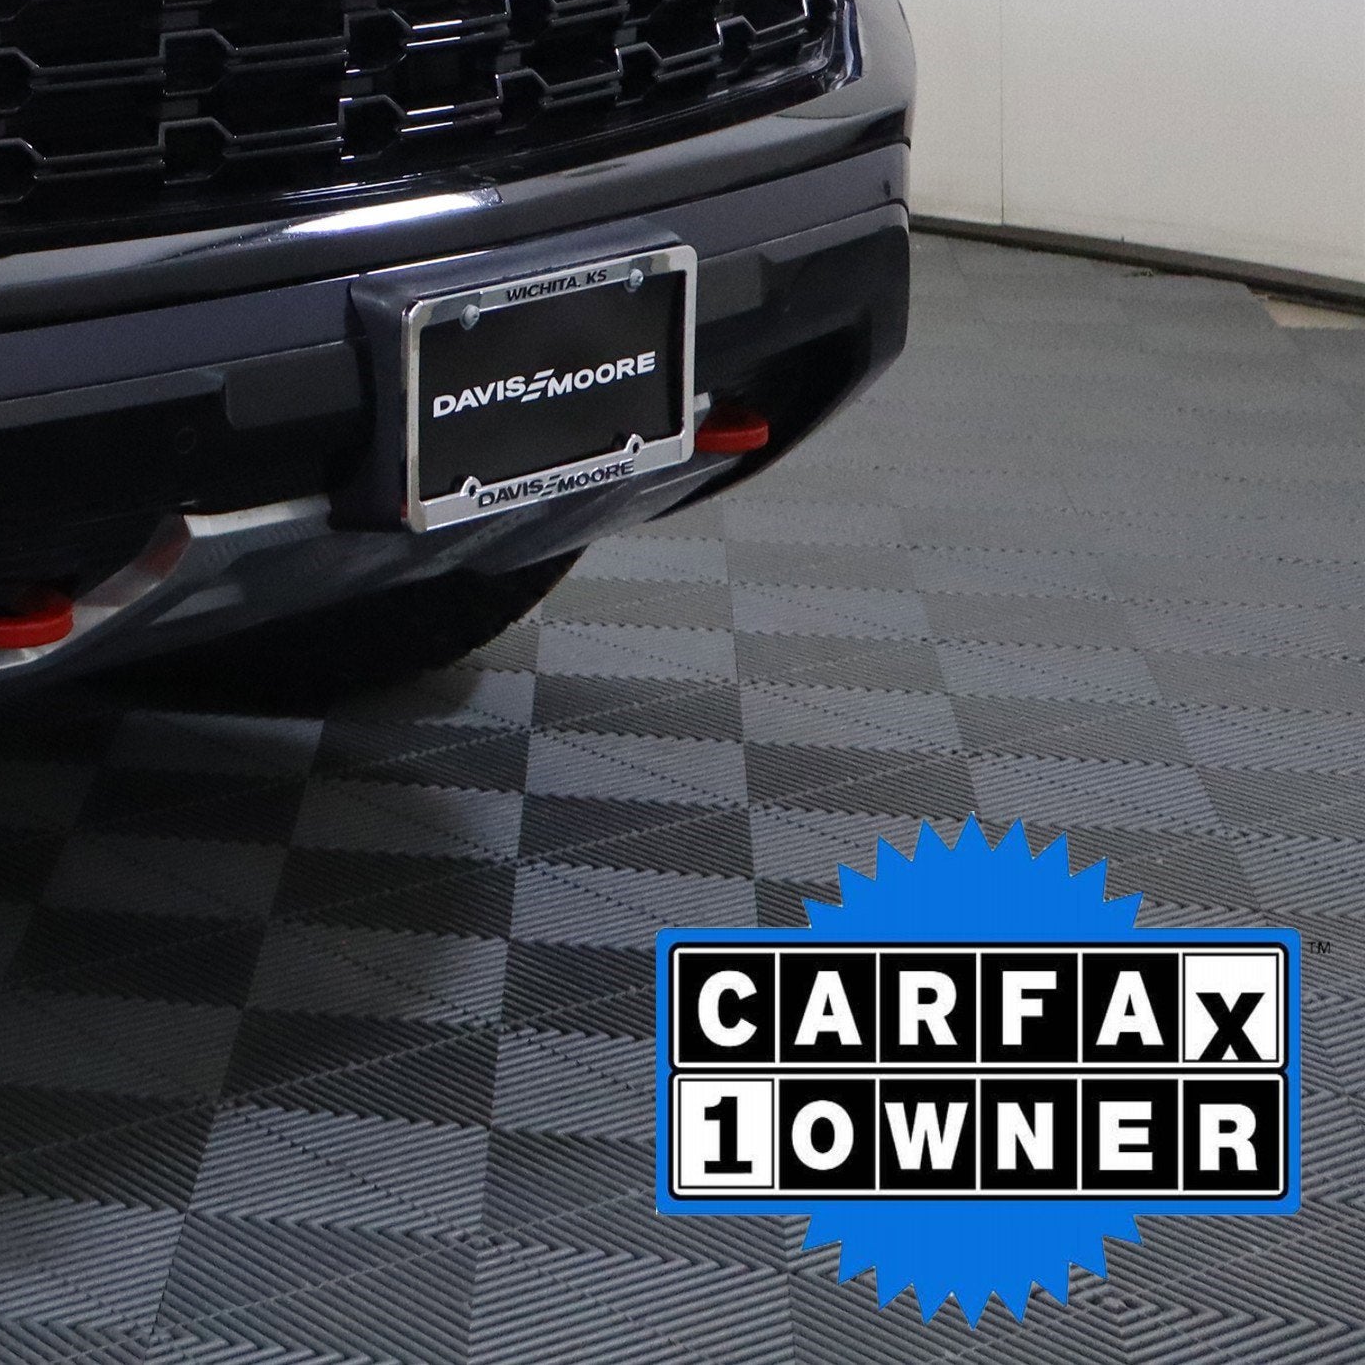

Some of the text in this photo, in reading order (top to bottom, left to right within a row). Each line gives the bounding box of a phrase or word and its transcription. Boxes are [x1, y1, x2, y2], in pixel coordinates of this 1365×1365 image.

[586, 269, 607, 285] KS
[433, 351, 656, 418] DAVIS MOORE
[478, 459, 634, 508] DAVIS MOORE
